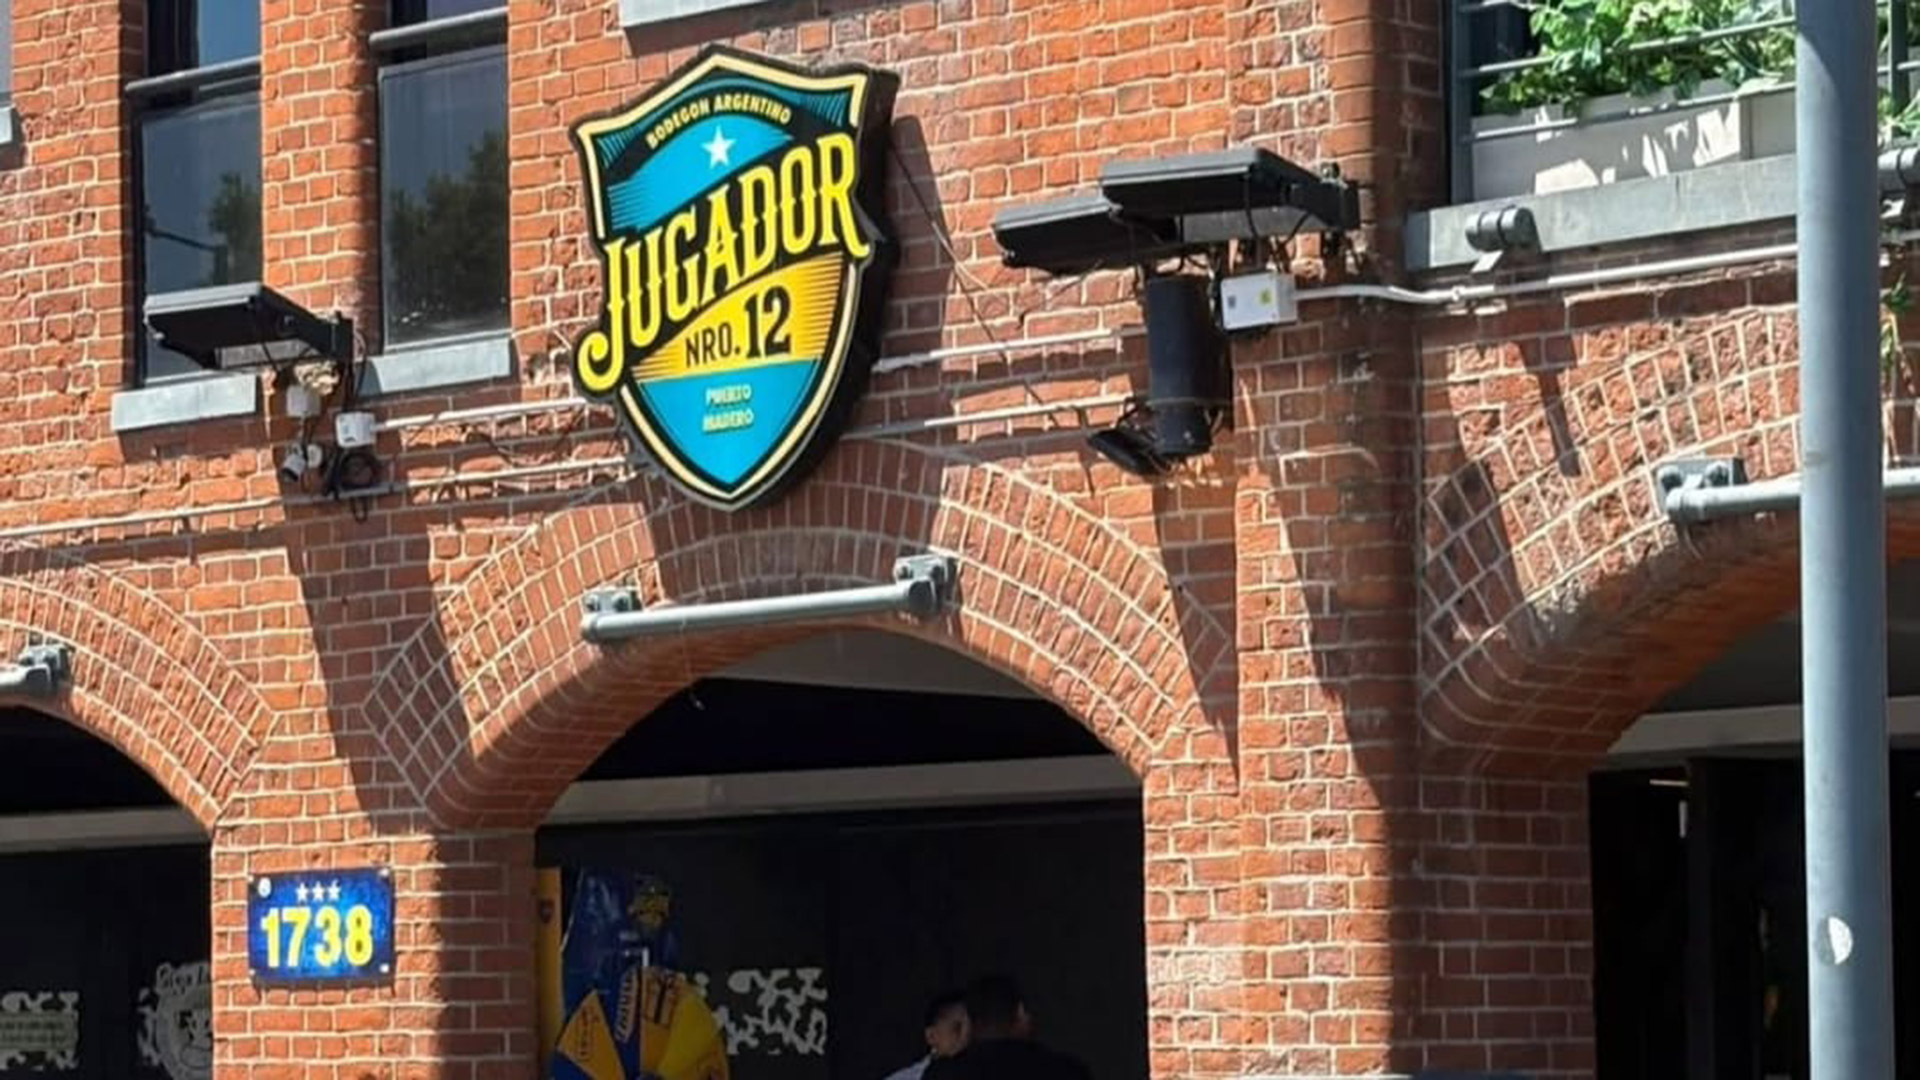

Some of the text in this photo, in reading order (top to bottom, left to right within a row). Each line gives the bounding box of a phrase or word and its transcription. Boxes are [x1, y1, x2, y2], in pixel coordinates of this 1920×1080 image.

[646, 94, 792, 149] BODEGON ARGENTINO
[577, 132, 871, 391] JUGADOR
[685, 285, 792, 368] NRO. 12
[260, 903, 373, 968] 1738
